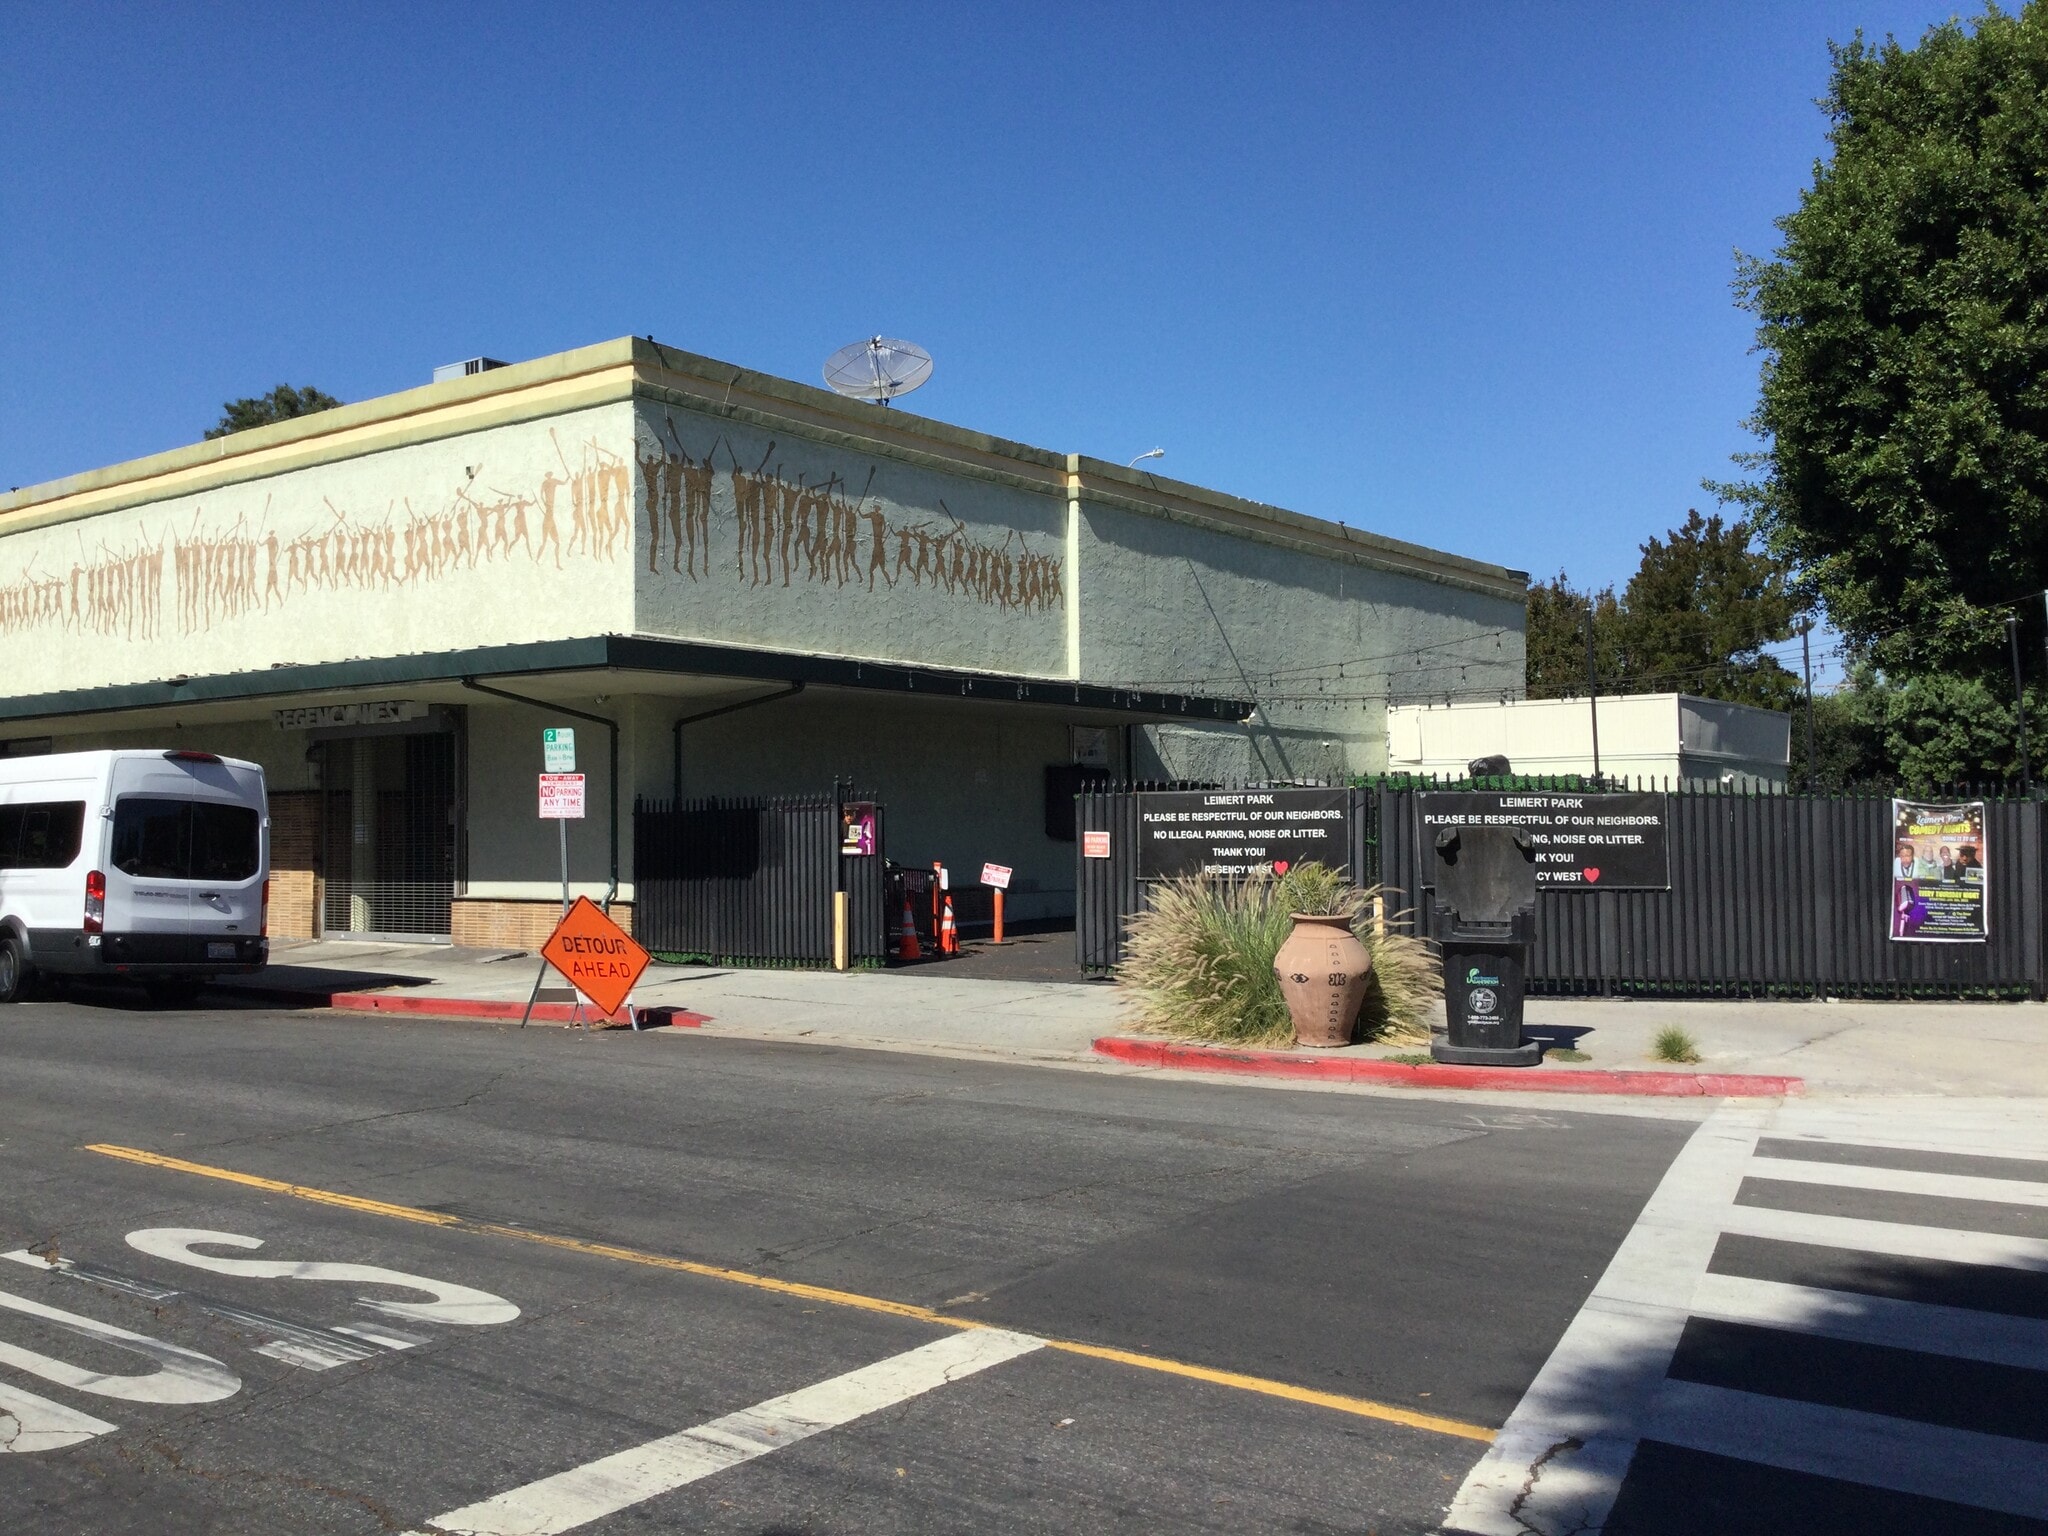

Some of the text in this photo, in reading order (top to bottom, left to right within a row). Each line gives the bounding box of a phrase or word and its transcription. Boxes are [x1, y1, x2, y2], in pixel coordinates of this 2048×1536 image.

[547, 731, 554, 741] 2
[546, 743, 574, 752] PARKING
[542, 787, 582, 797] NO PARKING
[543, 798, 581, 807] ANY TIME
[1204, 795, 1274, 805] LEIMERT PARK
[1500, 798, 1583, 808] LEIMERT PARK
[1144, 810, 1343, 822] PLEASE BE RESPECTFUL OF OUR NEIGHBORS.
[1424, 815, 1661, 825] PLEASE BE RESPECTFUL OF OUR NEIGHBORS.
[1153, 829, 1328, 840] NO ILLEGAL PARKING, NOISE OR LITTER.
[1553, 835, 1586, 844] NOISE
[1588, 835, 1604, 844] OR
[1606, 835, 1645, 844] LITTER.
[1212, 847, 1266, 856] THANK YOU!
[1549, 853, 1574, 862] YOU!
[1247, 865, 1273, 874] WST
[1553, 872, 1583, 881] WEST
[562, 936, 627, 955] DETOUR
[573, 961, 631, 978] AHEAD
